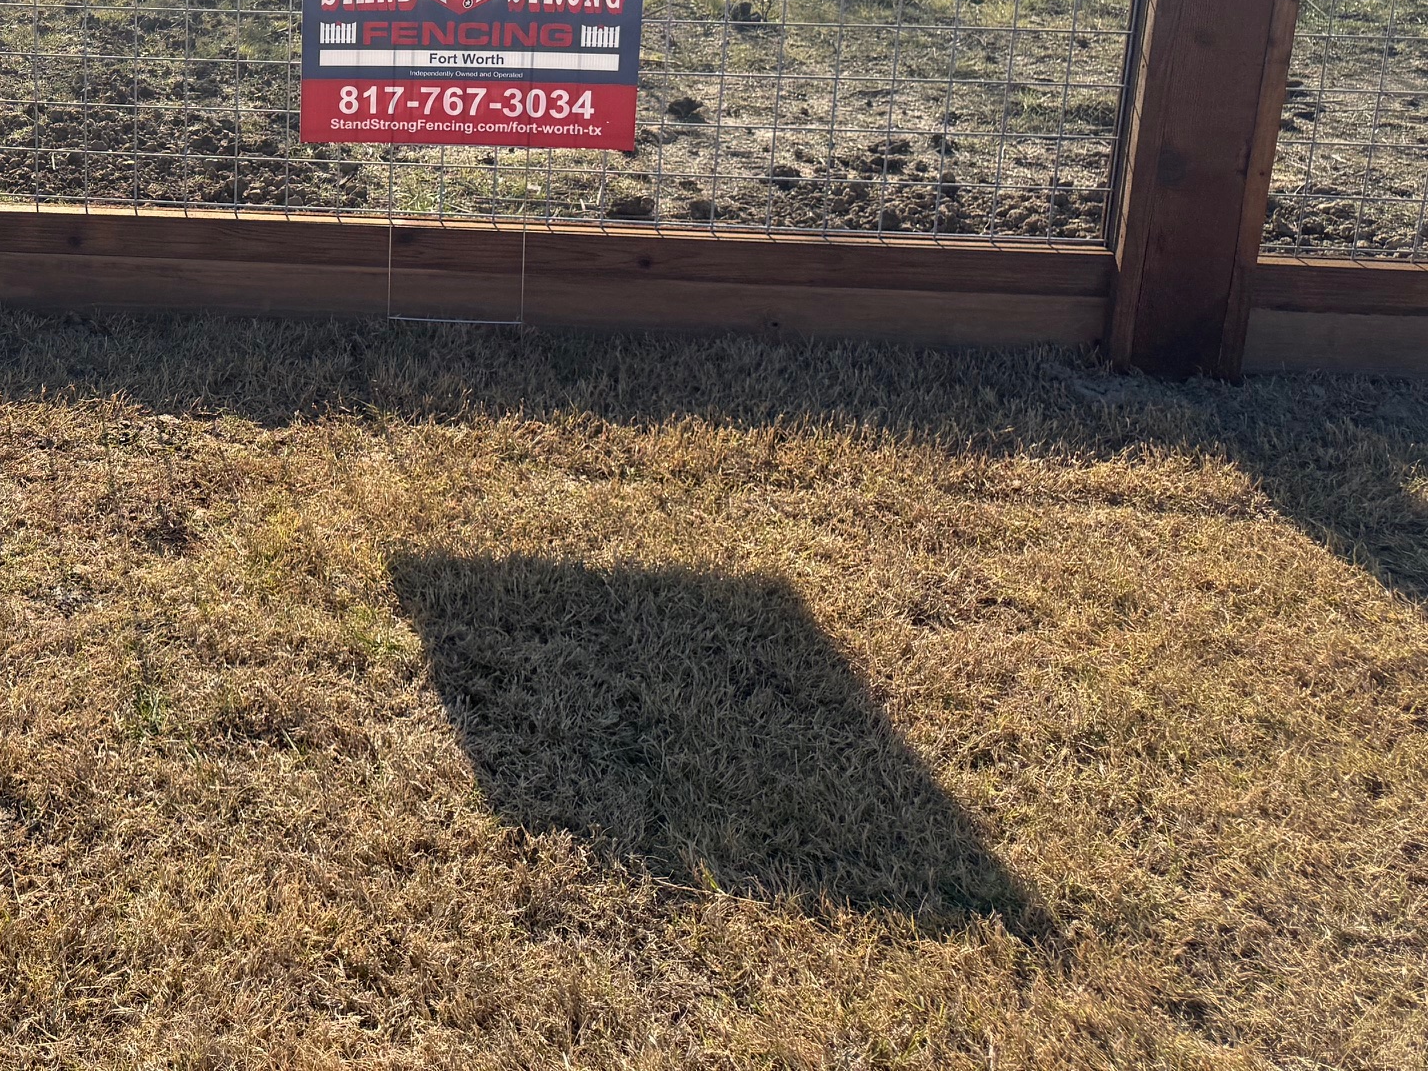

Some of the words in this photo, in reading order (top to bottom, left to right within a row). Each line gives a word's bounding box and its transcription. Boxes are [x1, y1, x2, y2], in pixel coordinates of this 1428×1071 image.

[362, 21, 573, 47] FENCING
[429, 53, 458, 65] Fort
[461, 53, 504, 65] Worth
[409, 70, 454, 78] Independently
[493, 71, 523, 79] Operated
[338, 85, 595, 120] 817-767-3034
[330, 117, 602, 137] StandStrongFencing.com/fort-worth-tx
